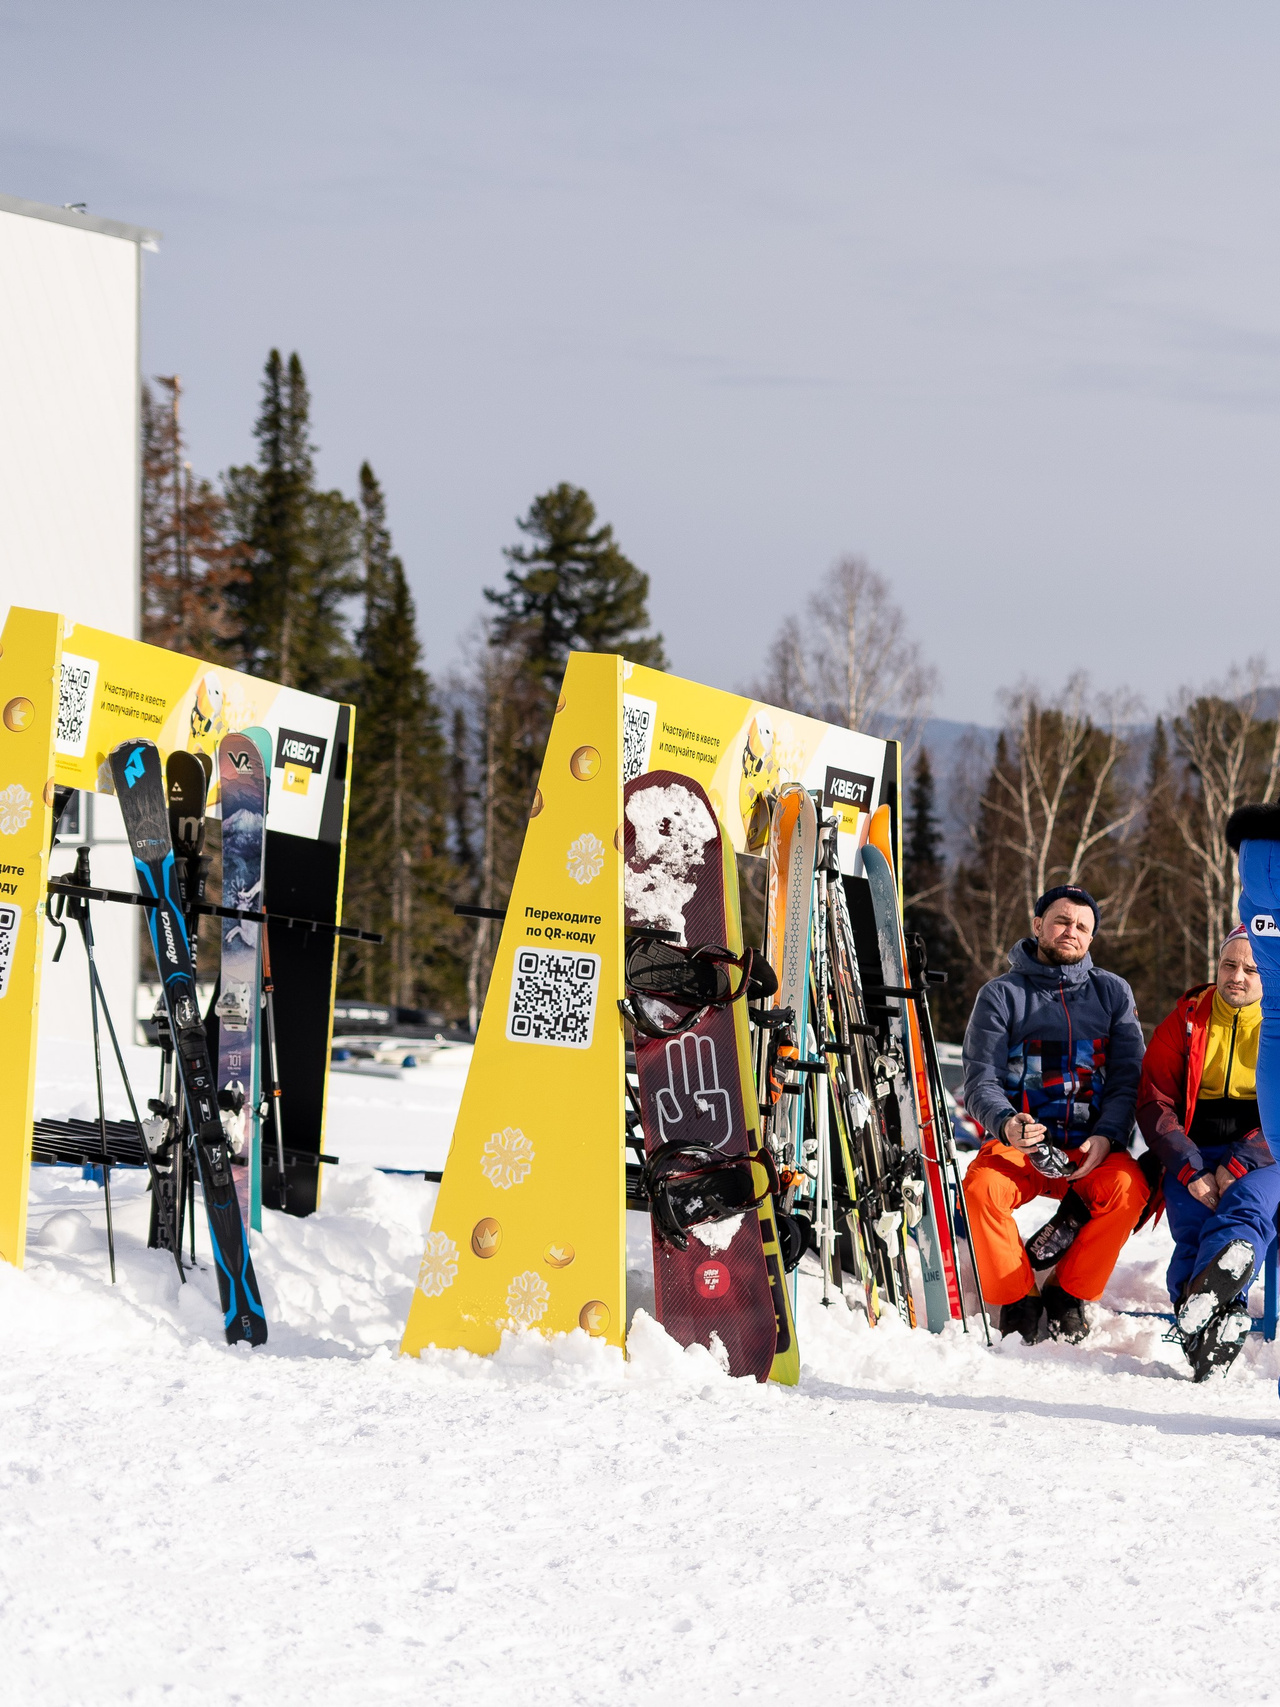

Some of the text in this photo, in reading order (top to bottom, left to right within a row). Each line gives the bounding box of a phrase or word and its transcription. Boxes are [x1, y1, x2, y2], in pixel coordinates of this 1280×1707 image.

[104, 681, 140, 701] Участвуйте
[145, 696, 166, 708] квесте
[106, 703, 139, 719] получайте
[140, 712, 163, 724] призы!
[662, 722, 696, 741] Участвуйте
[700, 735, 721, 747] квесте
[281, 738, 321, 764] КВЕСТ
[664, 743, 696, 759] получайте
[696, 751, 718, 765] призы!
[830, 777, 867, 802] КВЕСТ
[525, 906, 602, 925] Переходите
[160, 911, 179, 964] NORDICA
[526, 927, 596, 945] по QR-коду
[229, 1054, 242, 1066] 101
[924, 1270, 941, 1283] LINE
